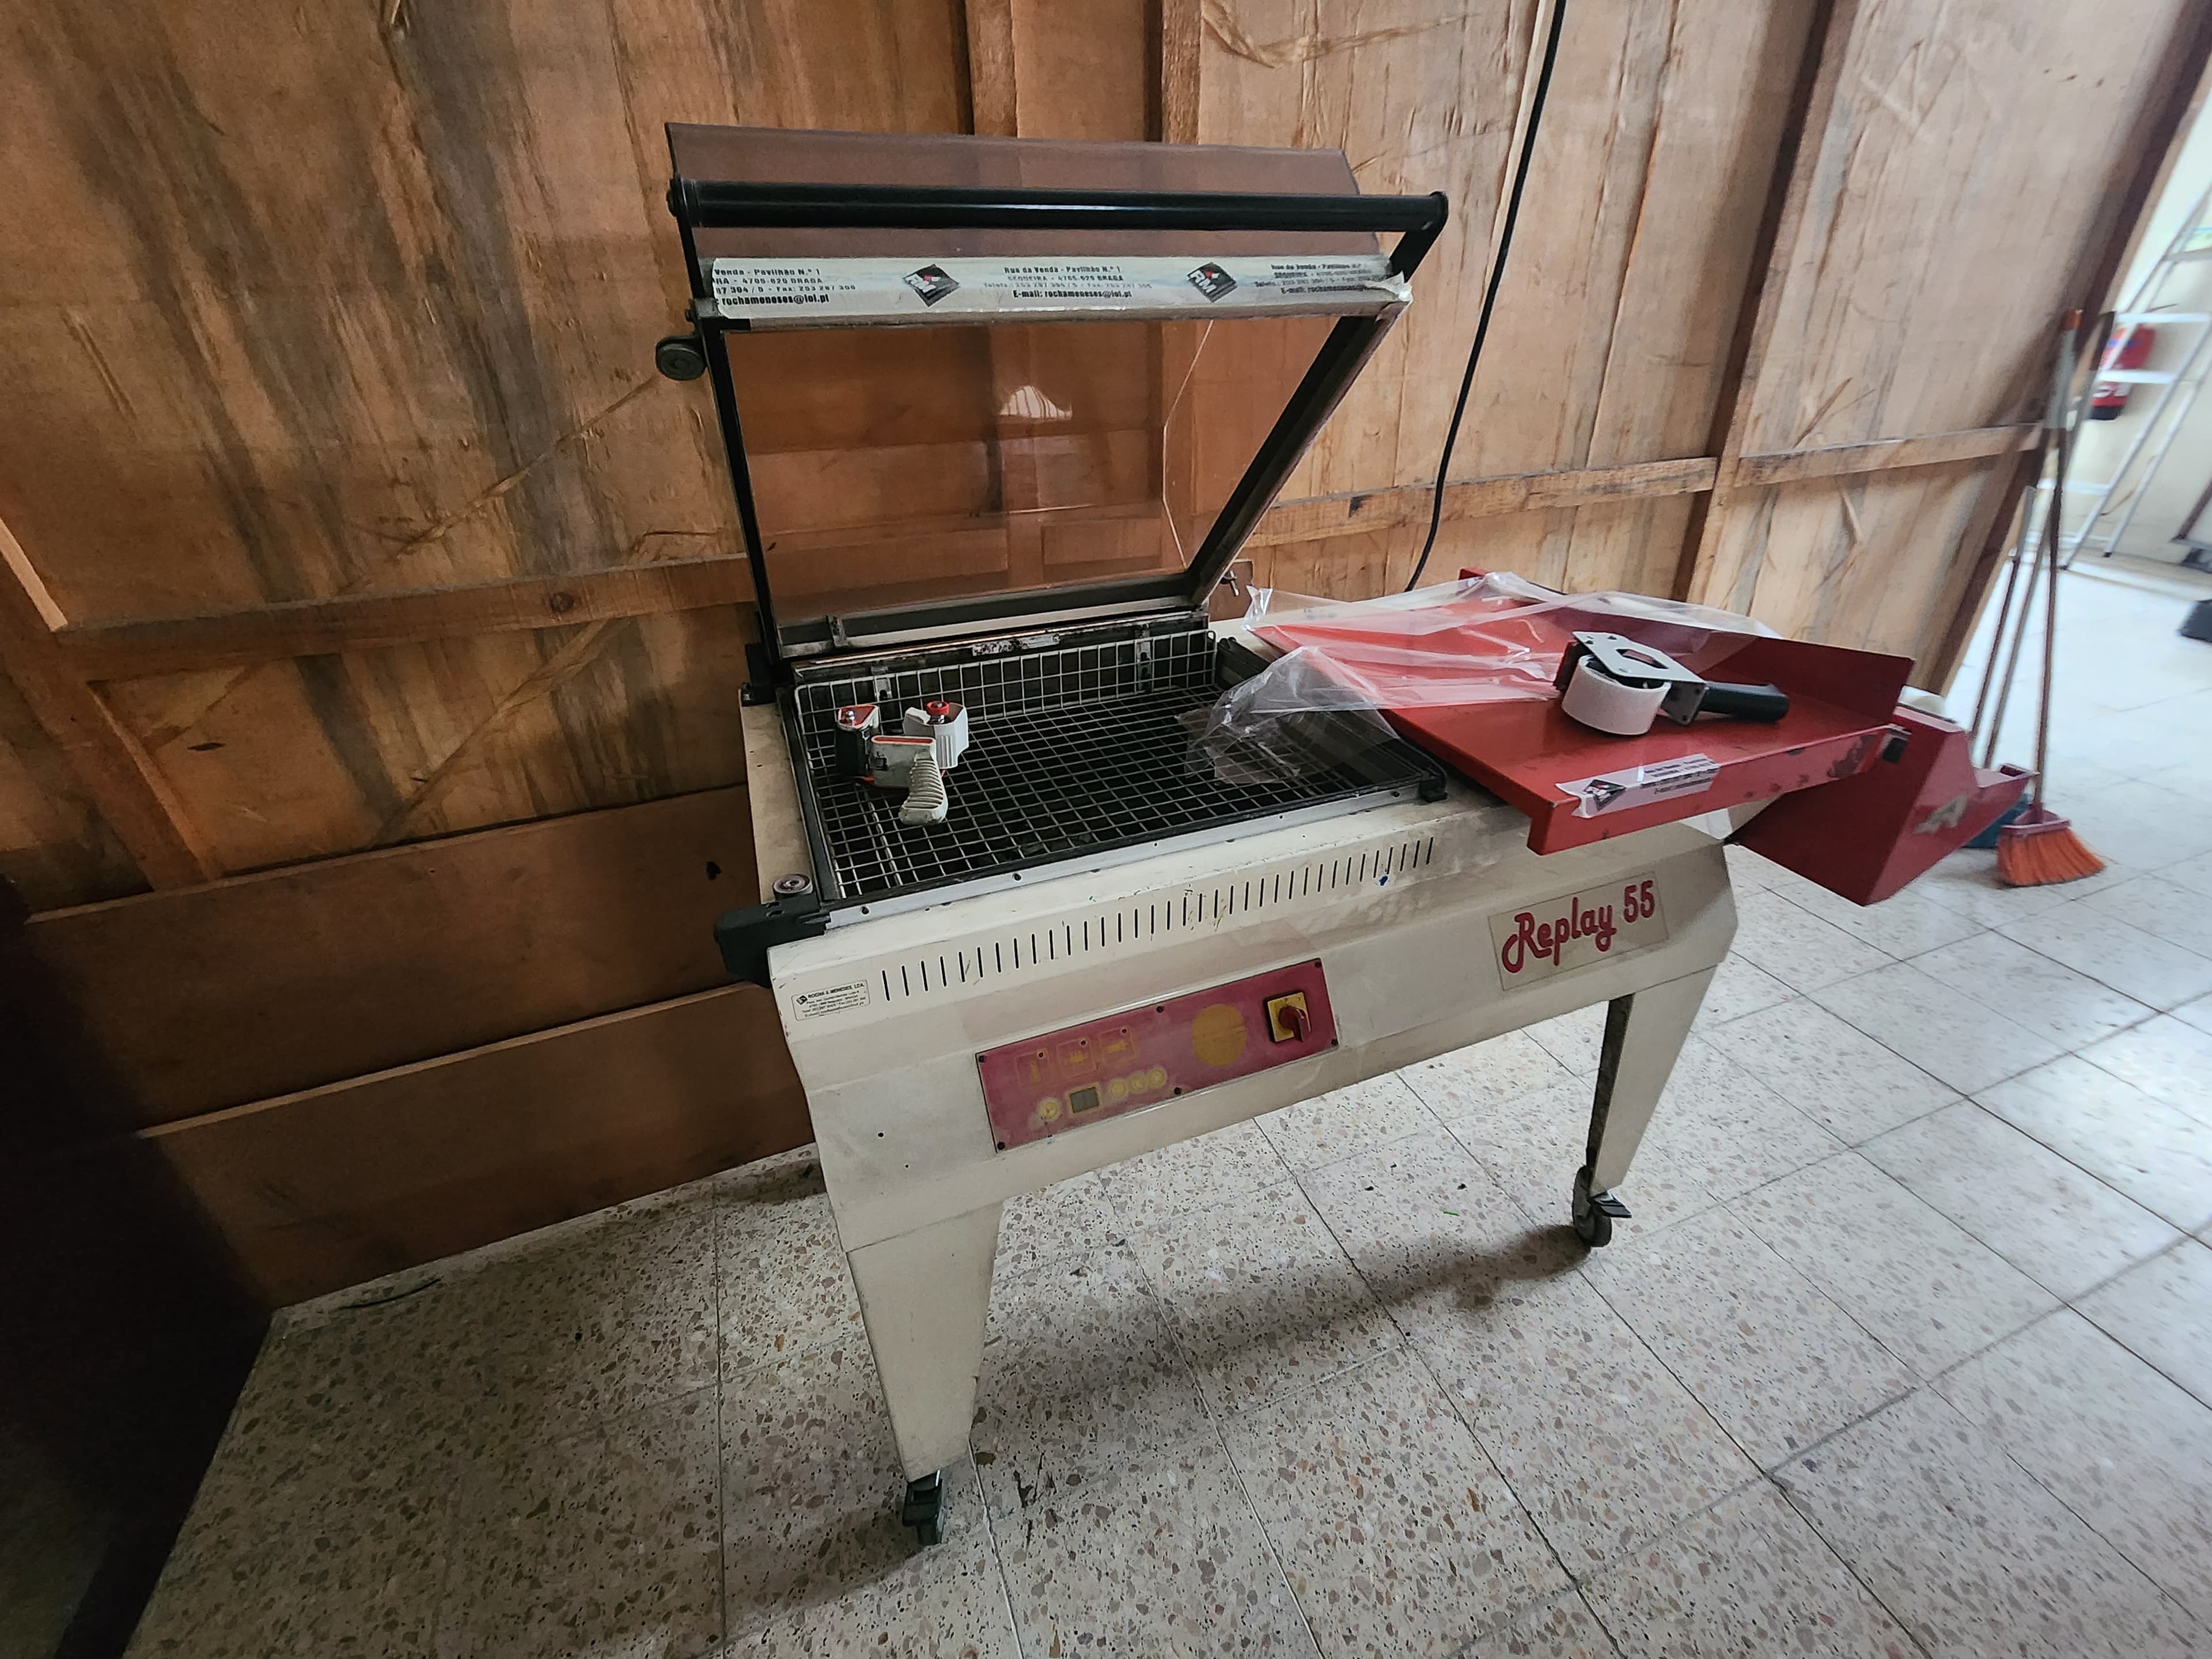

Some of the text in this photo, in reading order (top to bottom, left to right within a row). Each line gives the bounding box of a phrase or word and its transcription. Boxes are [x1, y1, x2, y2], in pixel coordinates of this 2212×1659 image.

[1189, 270, 1218, 293] RM
[1502, 880, 1655, 973] Replay 55
